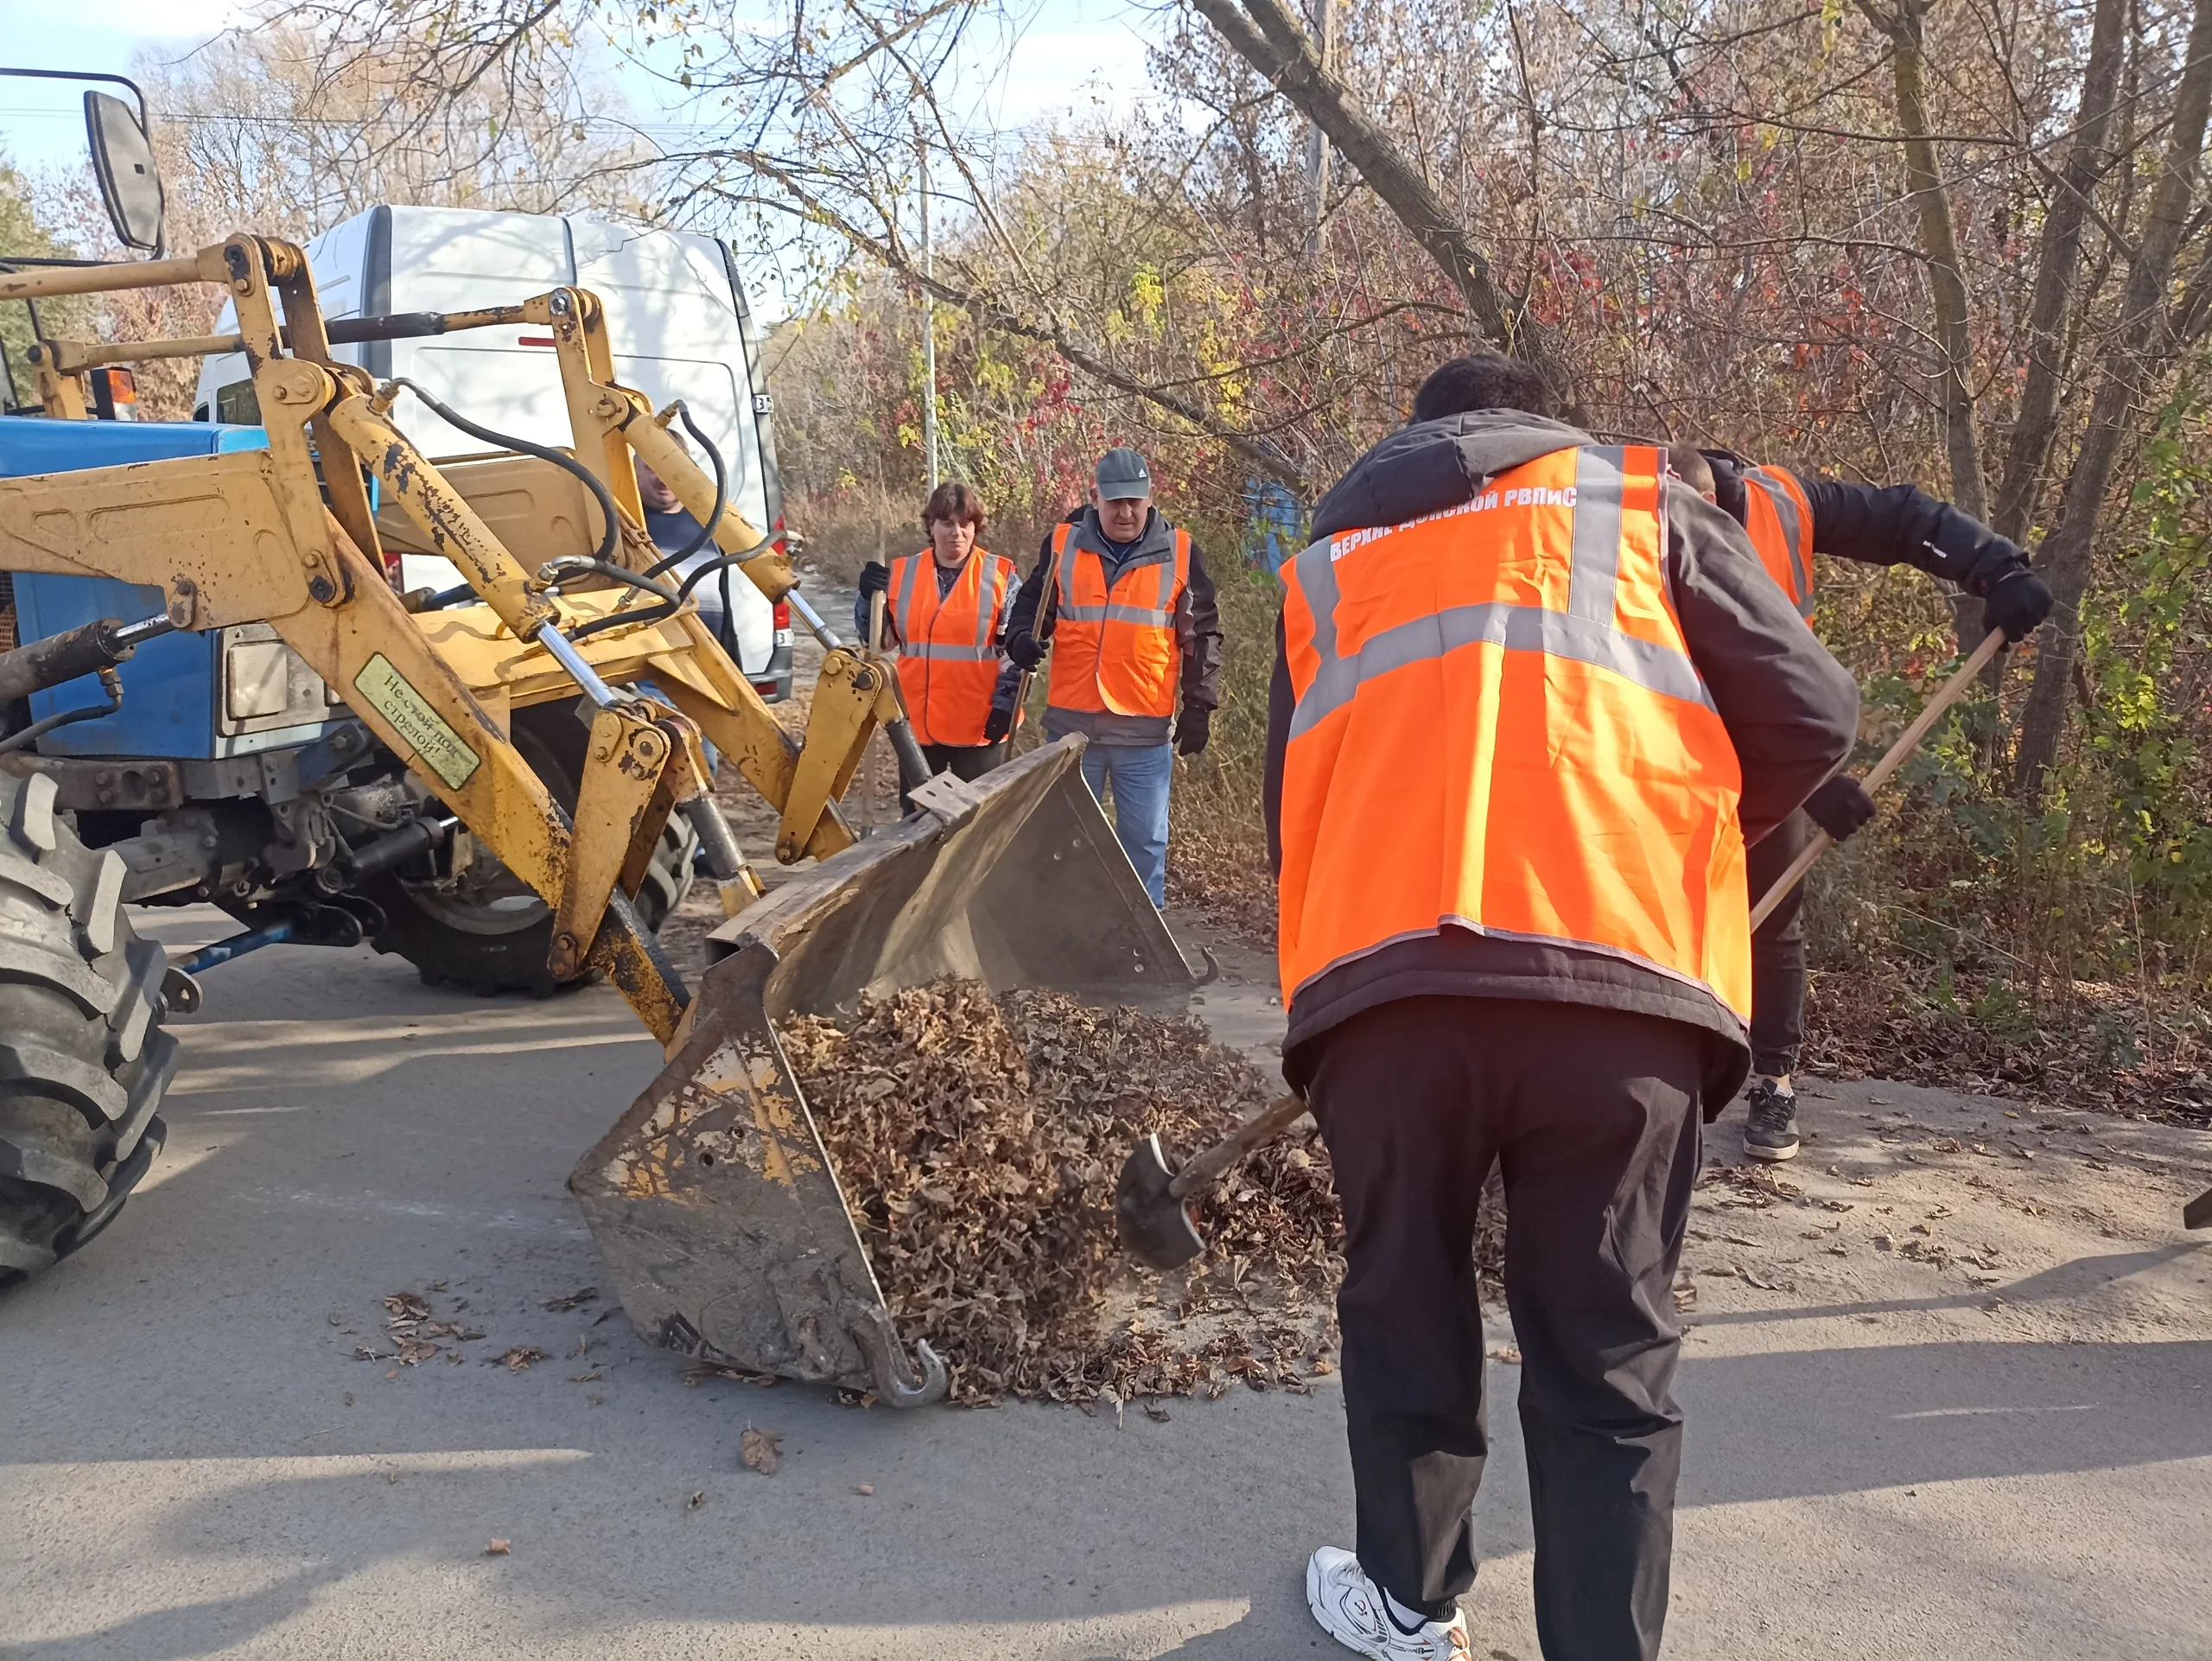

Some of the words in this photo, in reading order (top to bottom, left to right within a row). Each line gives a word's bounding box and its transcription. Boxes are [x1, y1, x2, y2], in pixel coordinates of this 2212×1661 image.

[384, 675, 404, 698] Не
[404, 698, 440, 730] стой
[434, 730, 460, 758] под
[384, 700, 441, 758] стрелой!
